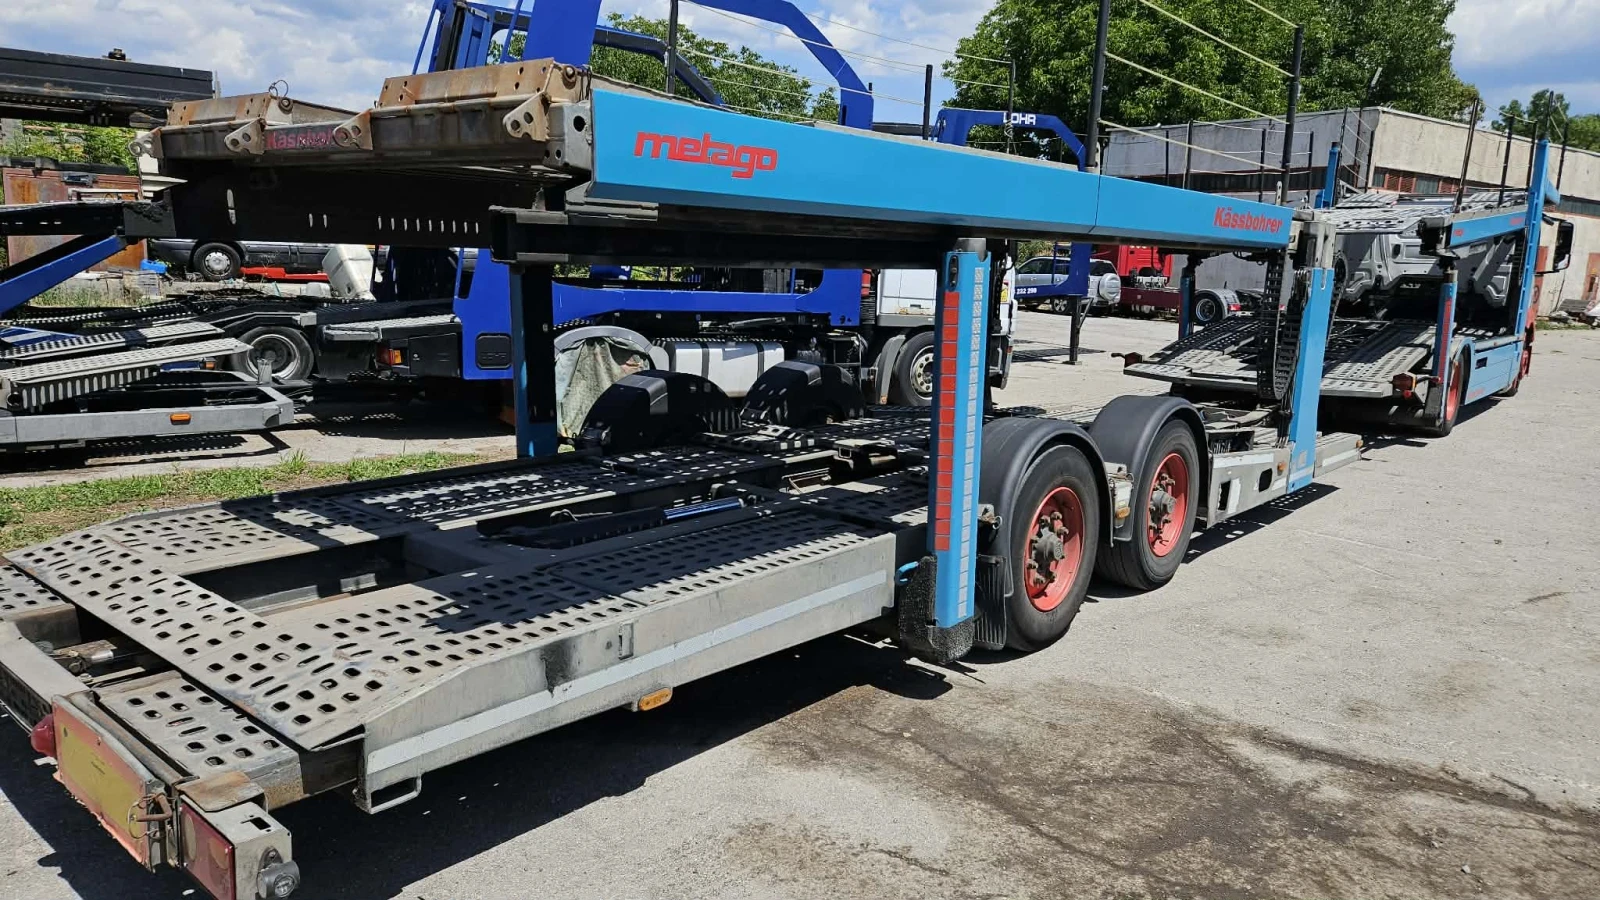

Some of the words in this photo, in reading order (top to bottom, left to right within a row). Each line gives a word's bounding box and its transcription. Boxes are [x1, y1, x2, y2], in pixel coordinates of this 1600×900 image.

[1003, 111, 1036, 125] LOHR
[633, 131, 778, 179] metago
[1213, 206, 1283, 233] Kässbohrer
